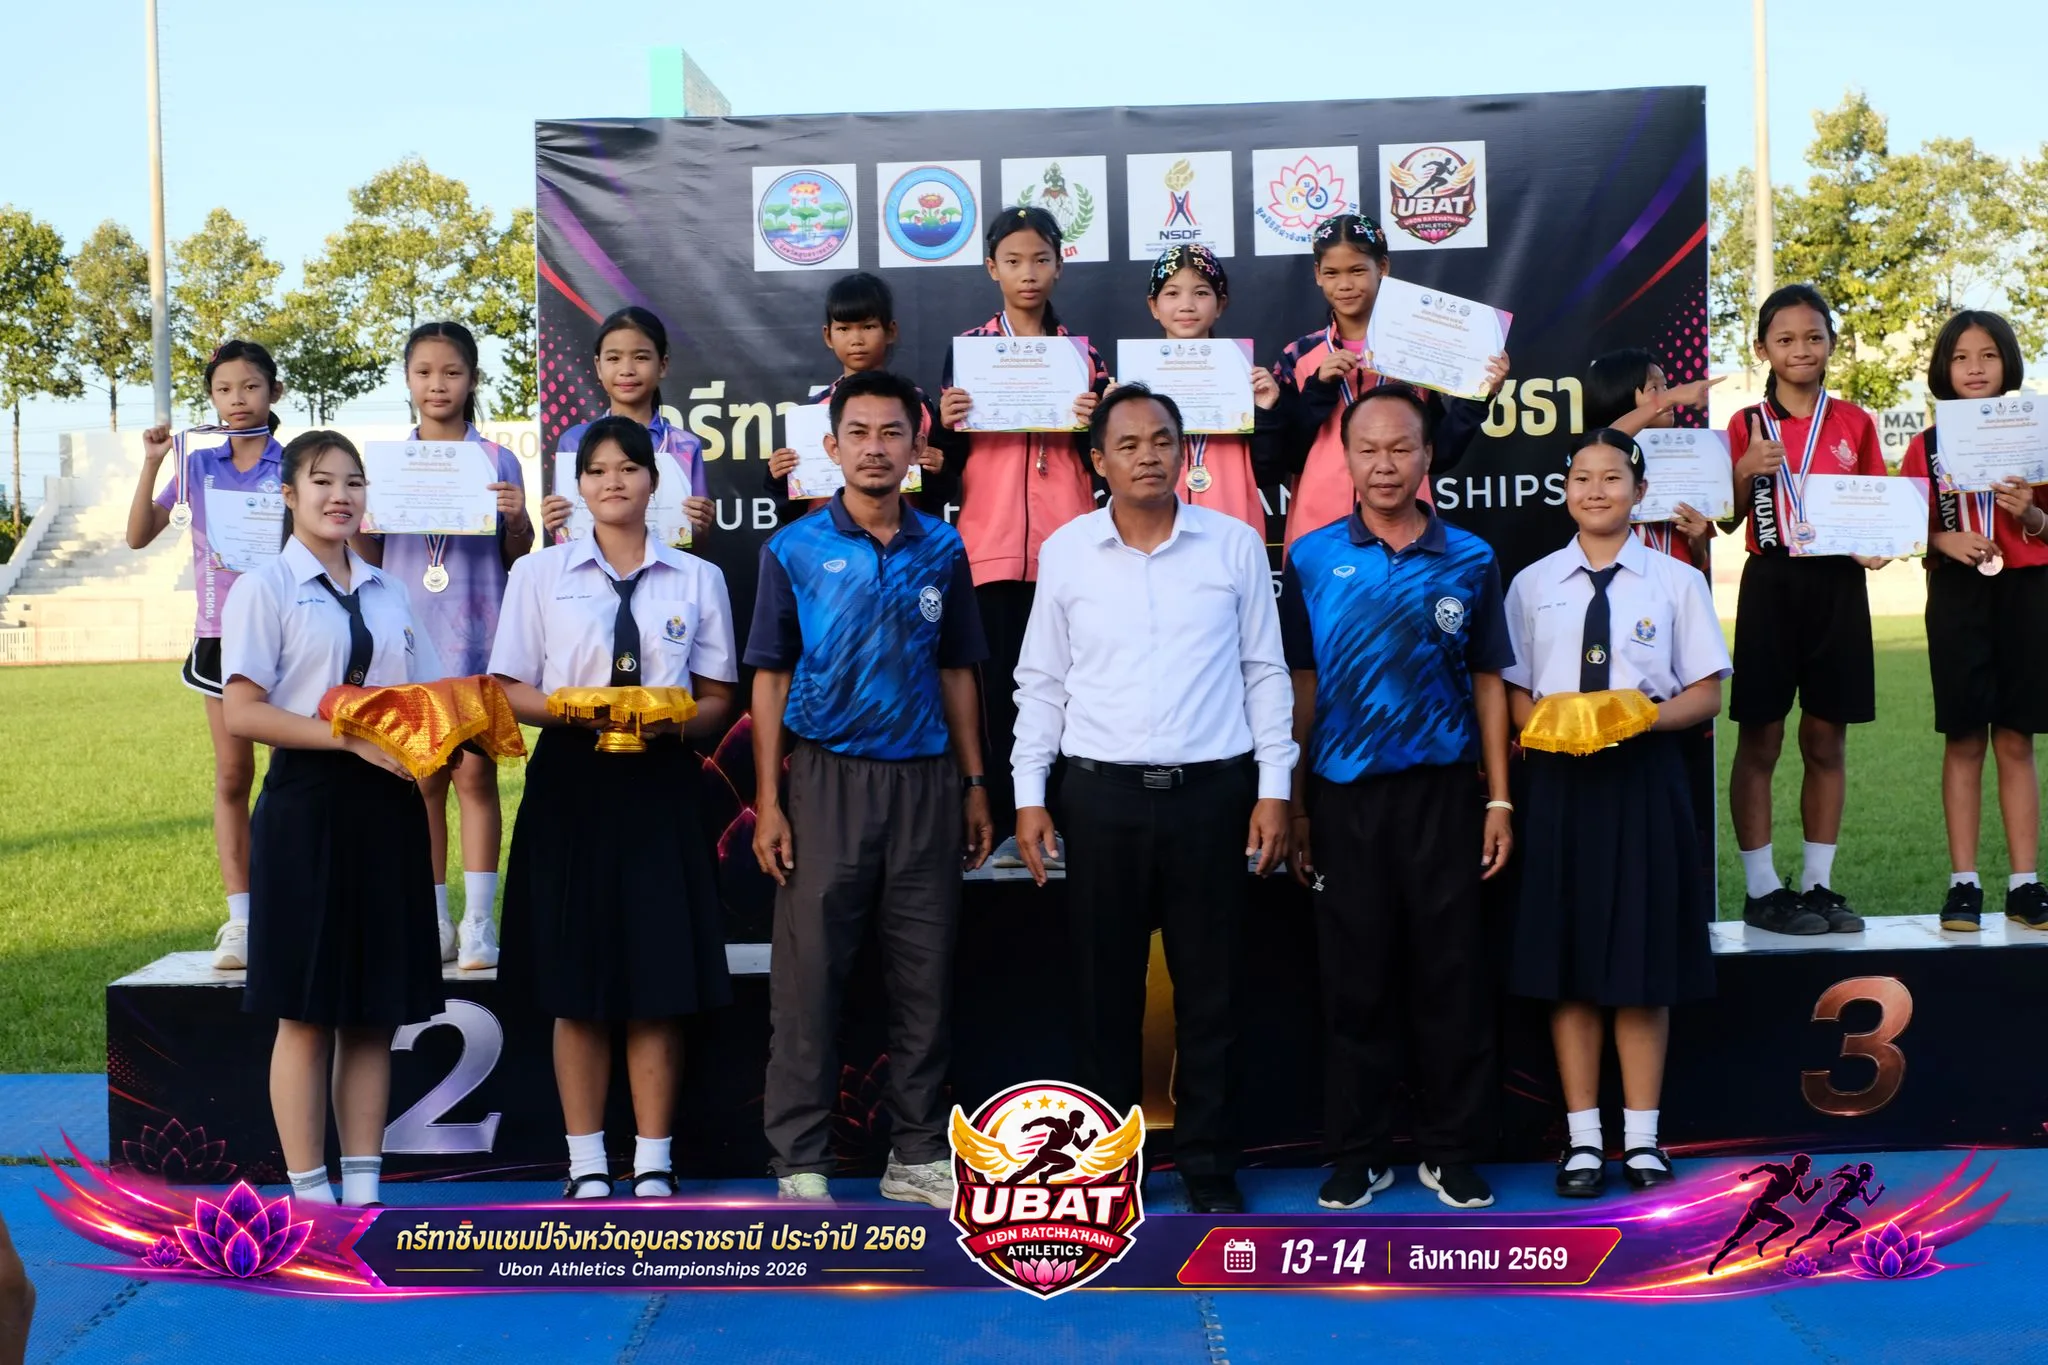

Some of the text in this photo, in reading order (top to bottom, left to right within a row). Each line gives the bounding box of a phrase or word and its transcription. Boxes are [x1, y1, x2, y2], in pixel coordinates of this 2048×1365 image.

[1397, 195, 1470, 217] UBAT
[1159, 229, 1202, 241] NSDF
[205, 586, 215, 620] SCHOOL
[1800, 975, 1914, 1117] 3
[381, 999, 504, 1154] 2
